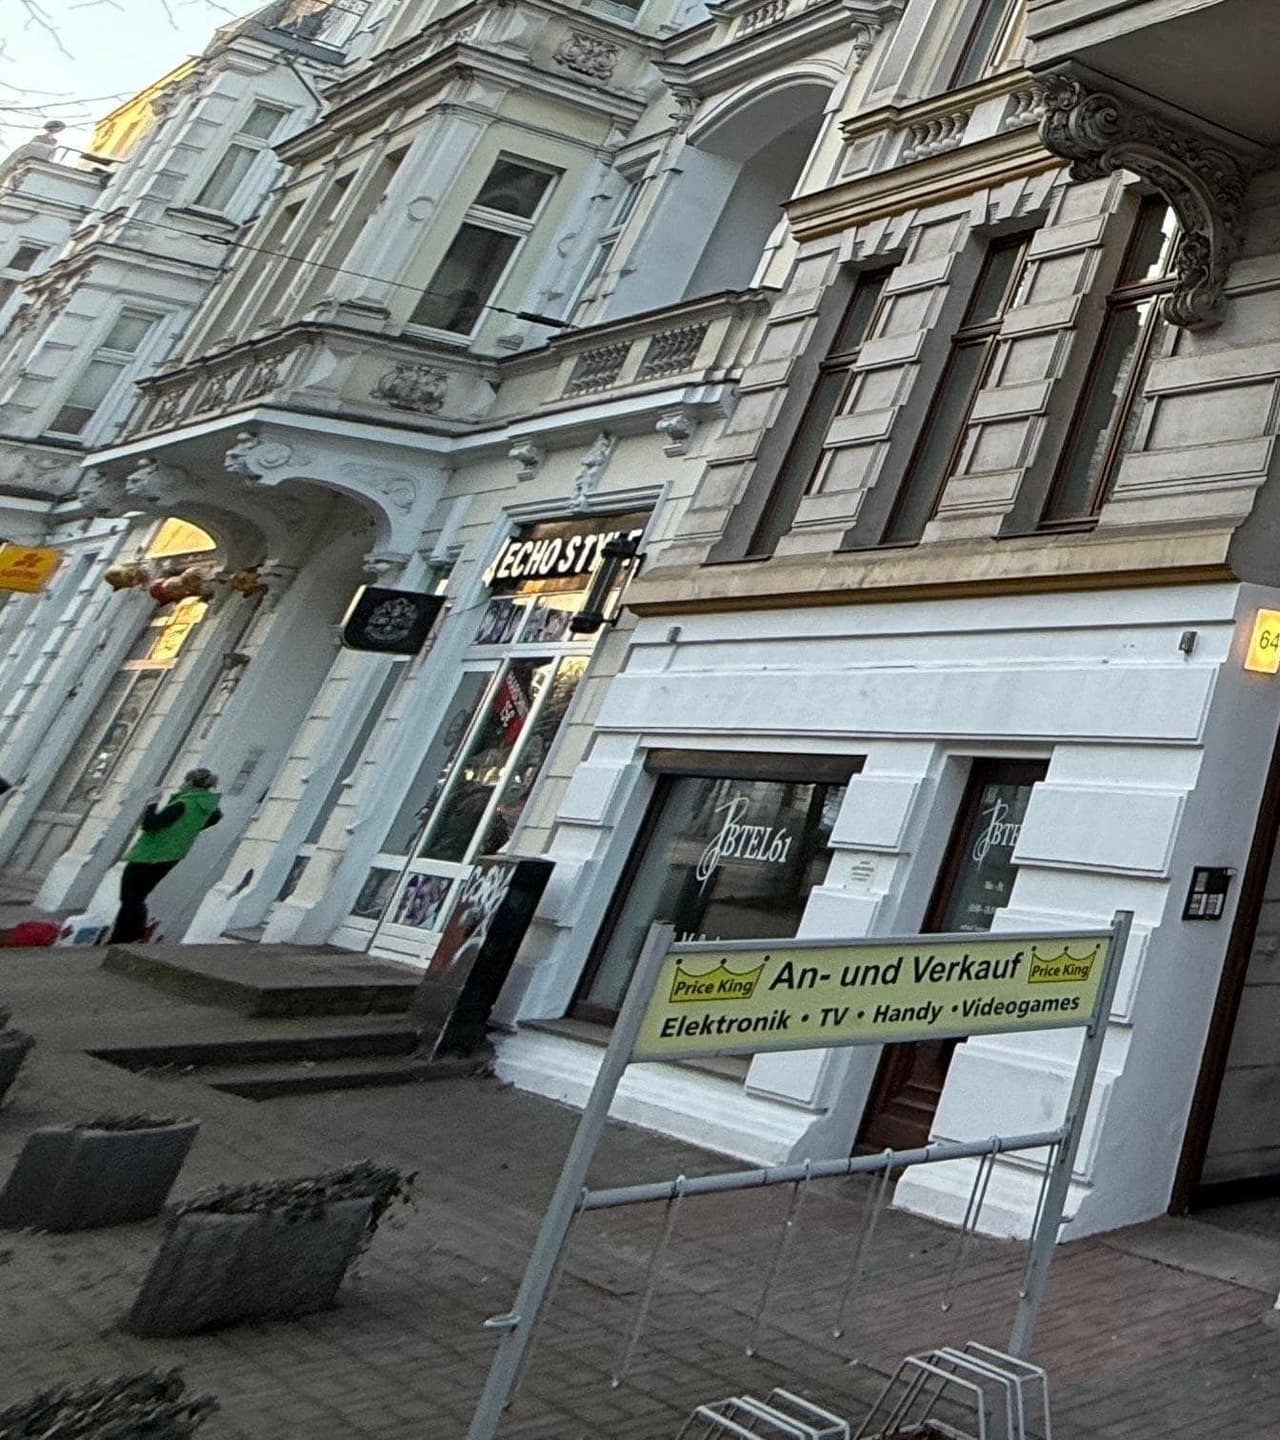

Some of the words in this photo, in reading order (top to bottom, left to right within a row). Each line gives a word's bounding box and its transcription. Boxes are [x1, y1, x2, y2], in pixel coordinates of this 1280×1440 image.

[496, 537, 562, 578] ECHO
[1259, 630, 1280, 652] 64
[674, 981, 713, 996] Price
[717, 979, 754, 997] King
[768, 961, 831, 991] An-
[840, 957, 904, 987] und
[913, 951, 1025, 983] Verkauf
[1031, 963, 1060, 977] Price
[1062, 962, 1090, 979] King
[659, 1009, 791, 1039] Elektronik
[820, 1007, 849, 1027] TV
[872, 1000, 944, 1025] Handy
[961, 994, 1081, 1019] Videogames
